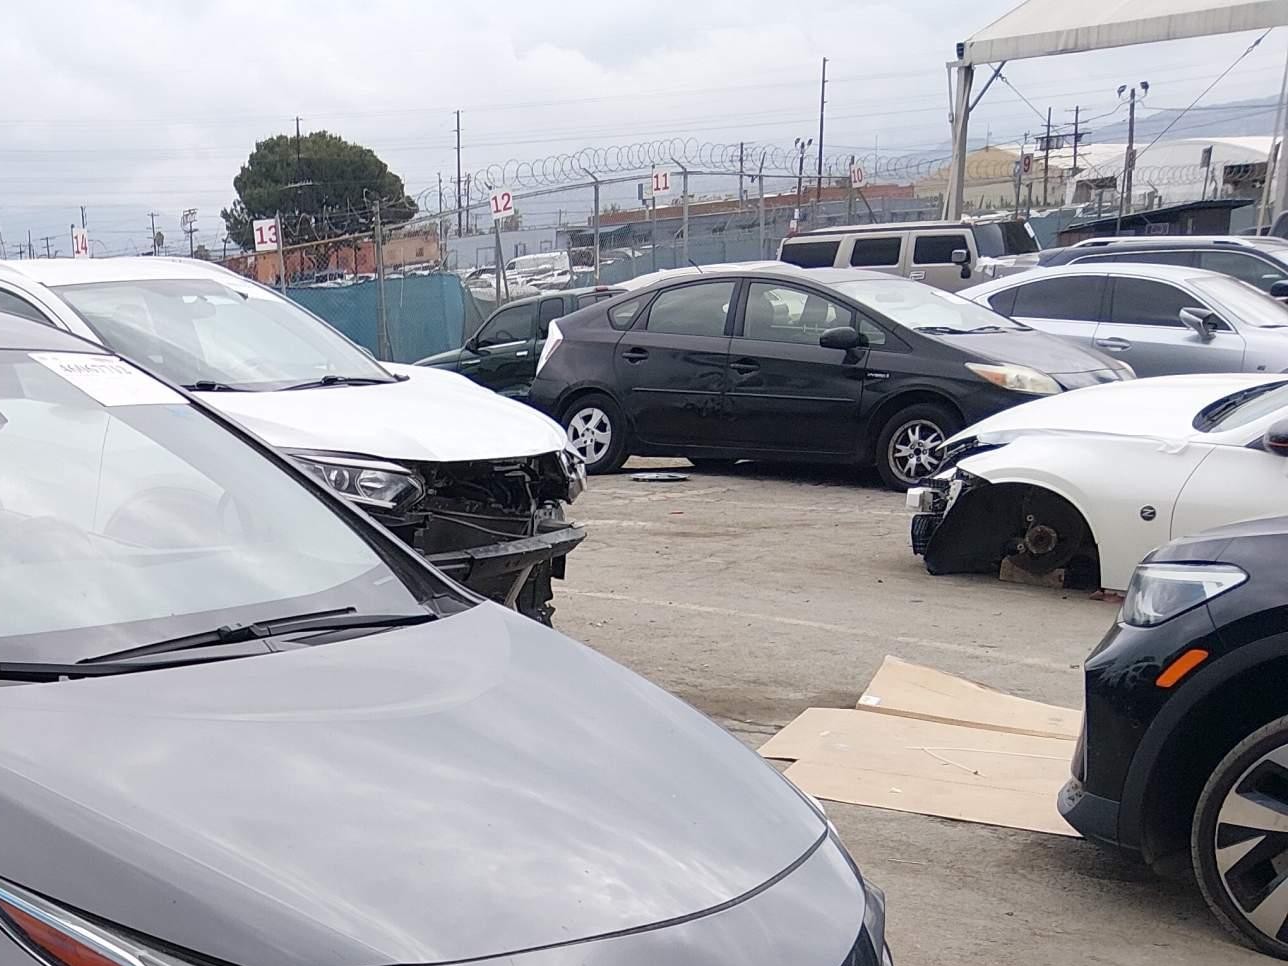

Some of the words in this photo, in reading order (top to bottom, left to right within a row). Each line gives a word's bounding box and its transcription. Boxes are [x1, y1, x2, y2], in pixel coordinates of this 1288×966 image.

[1023, 155, 1031, 173] 9
[653, 173, 670, 191] 11
[852, 167, 863, 183] 10
[491, 192, 513, 214] 12
[255, 224, 277, 245] 13
[74, 234, 88, 255] 14
